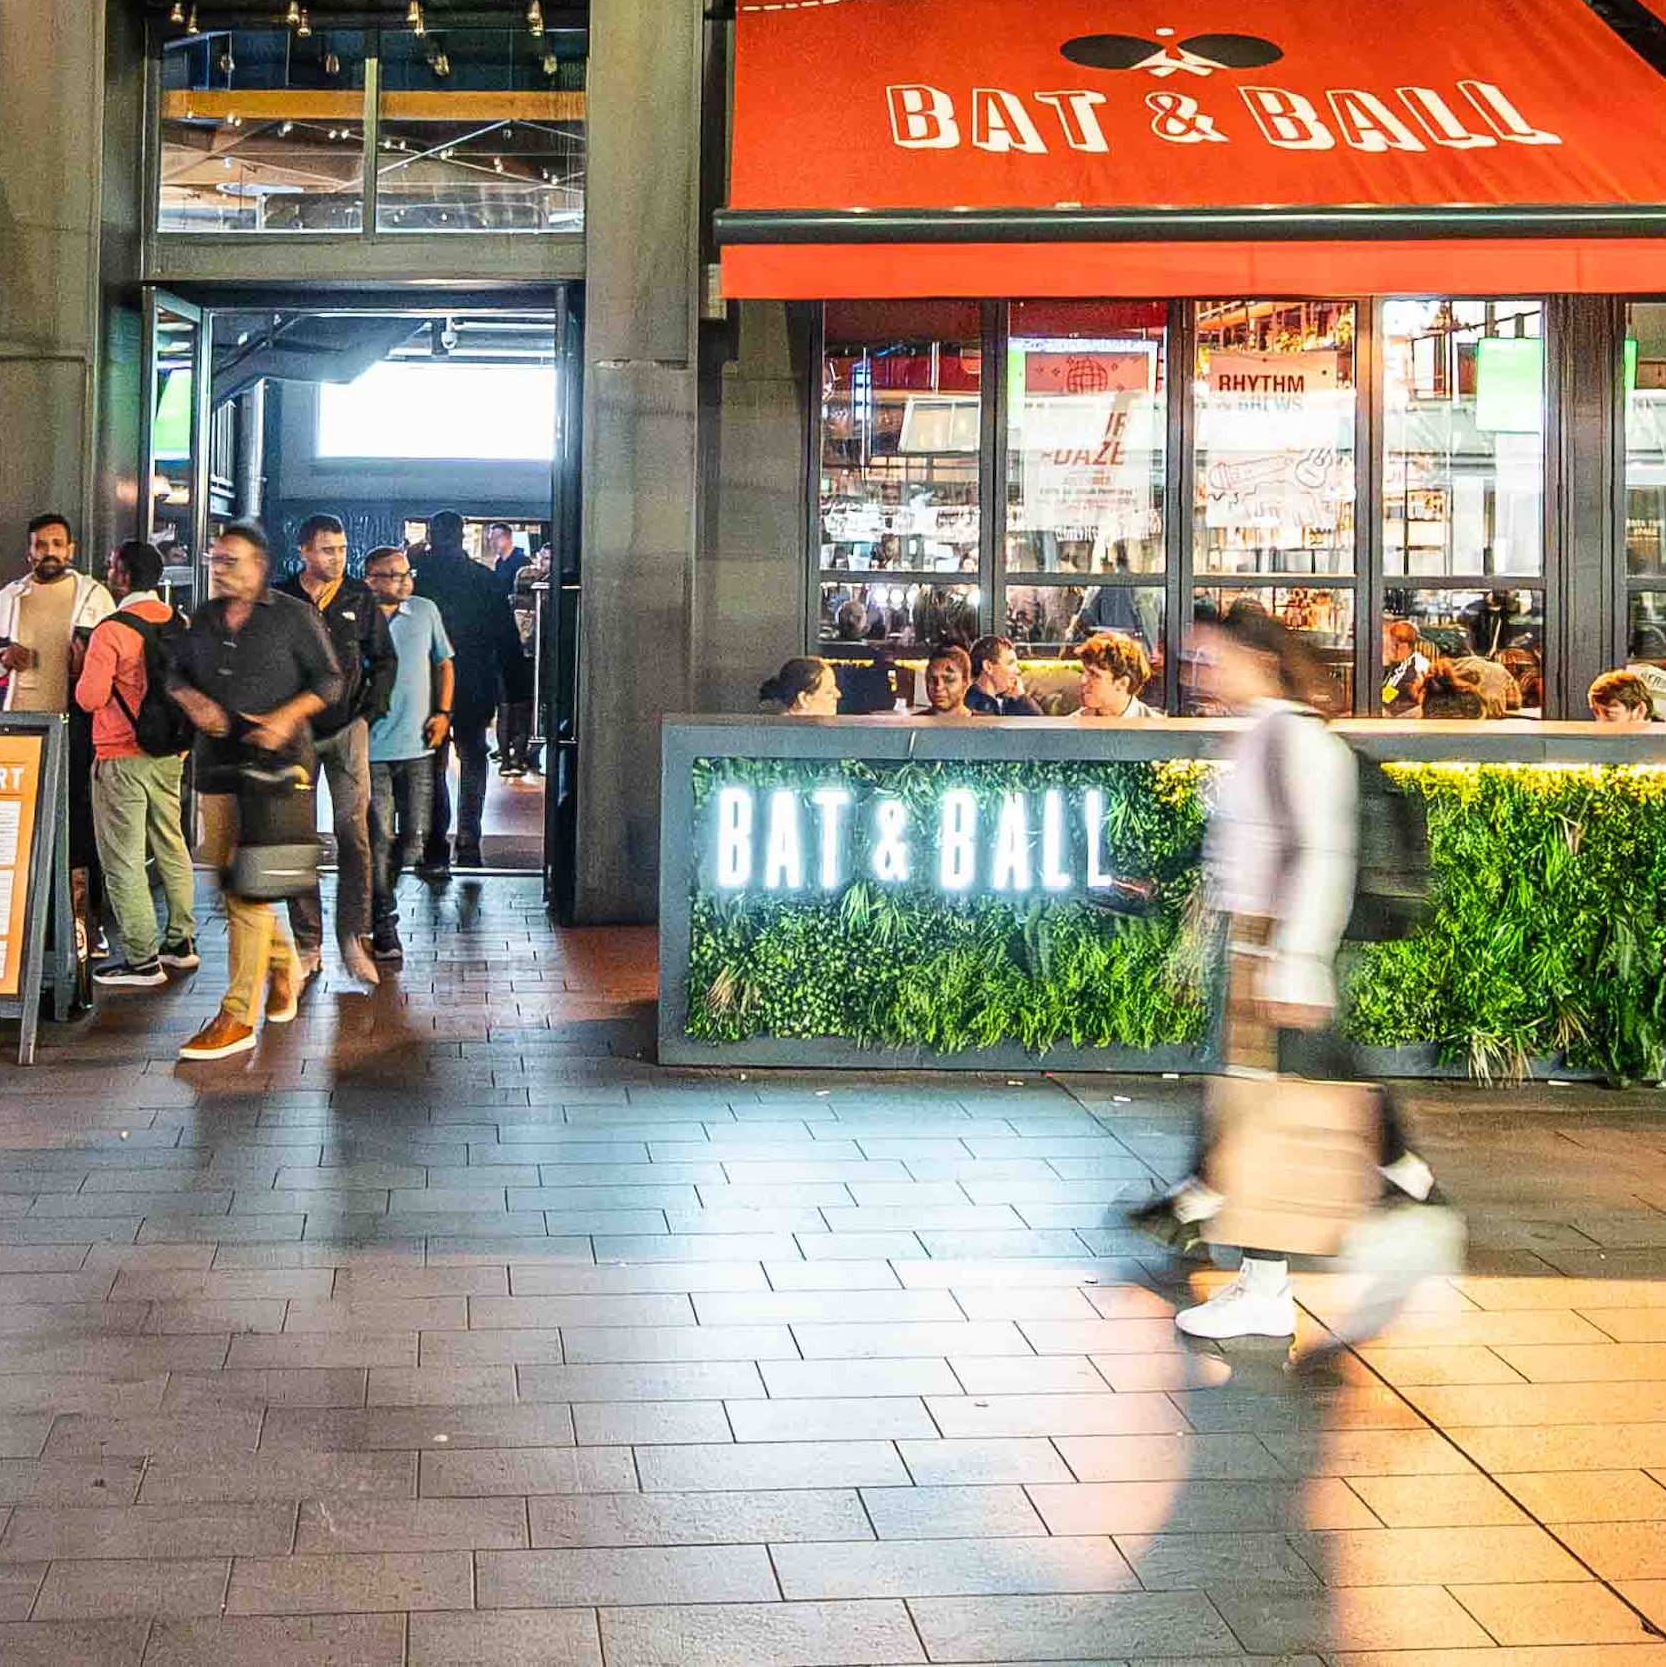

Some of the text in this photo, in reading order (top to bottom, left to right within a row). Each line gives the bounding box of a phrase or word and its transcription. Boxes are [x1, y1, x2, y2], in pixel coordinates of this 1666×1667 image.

[885, 79, 1563, 154] BAT & BALL
[1218, 373, 1305, 393] RHYTHM
[716, 787, 1114, 890] BAT & BALL
